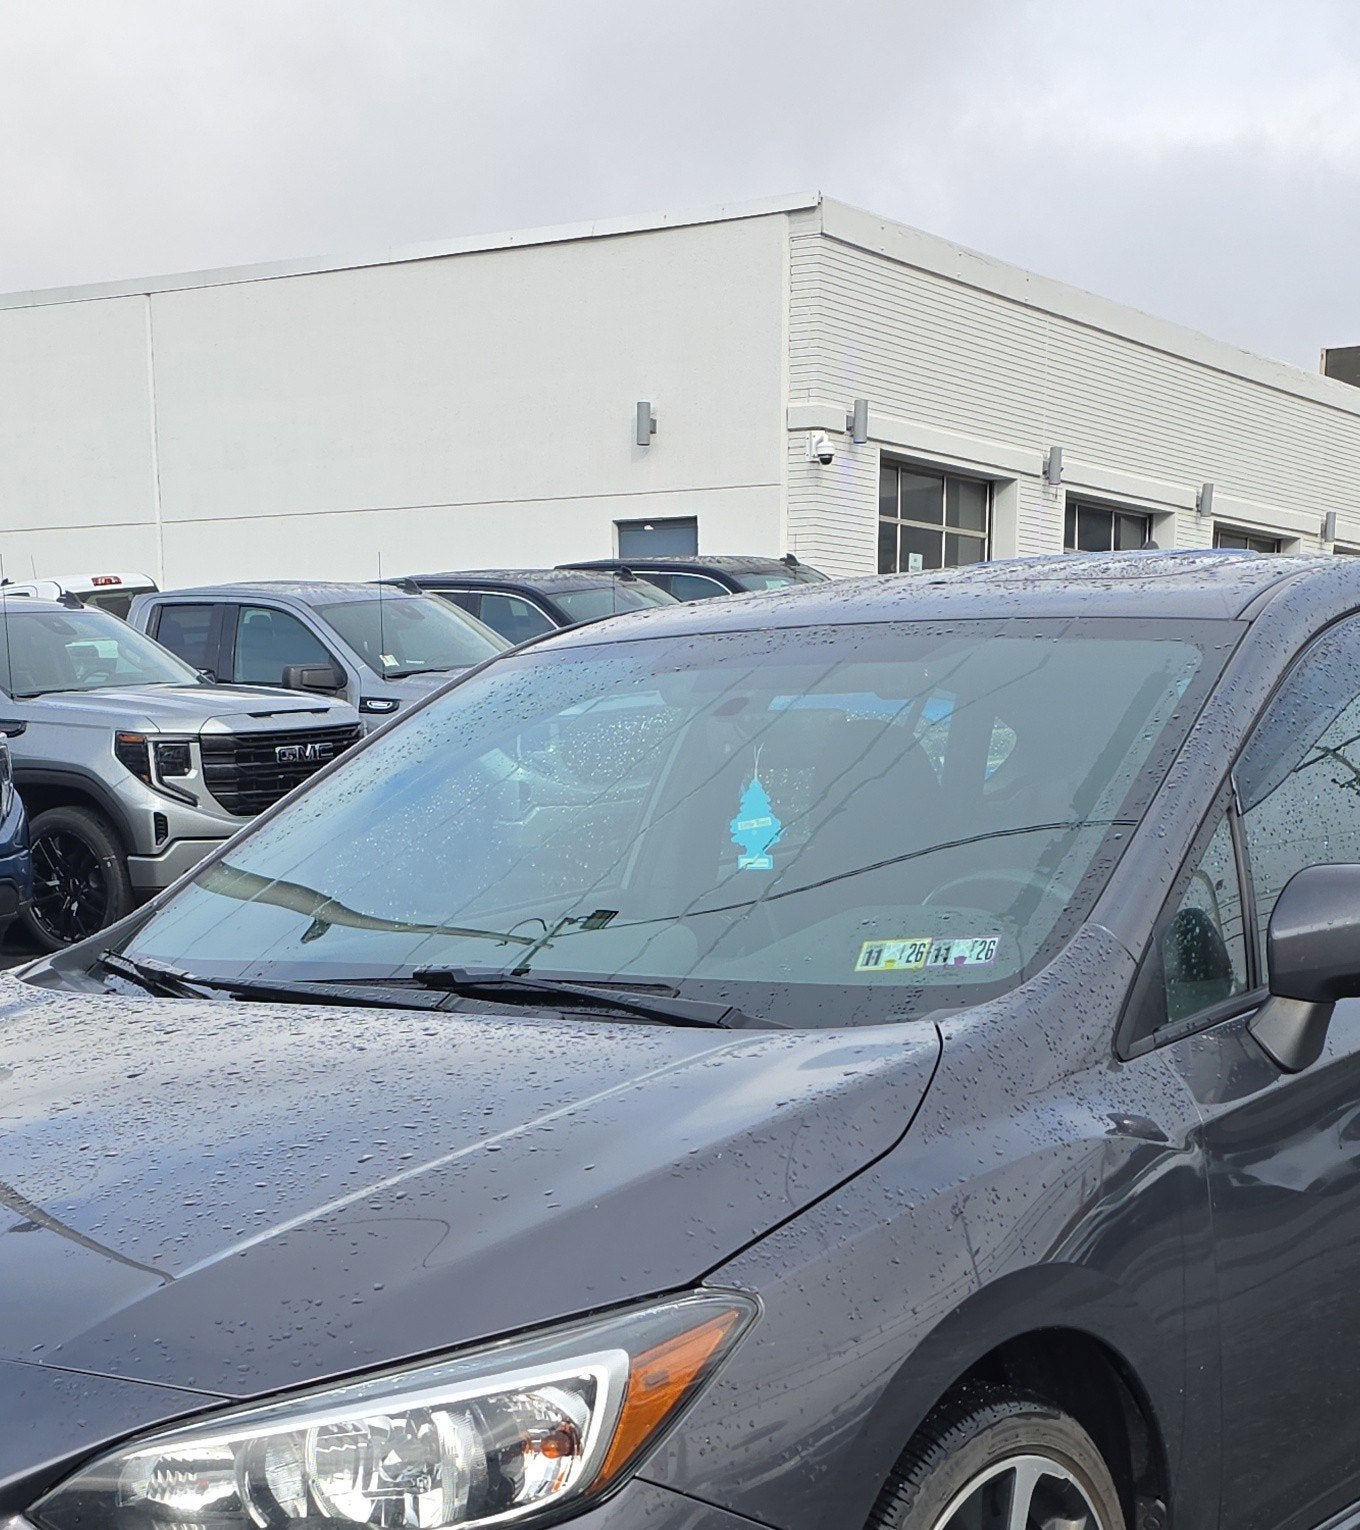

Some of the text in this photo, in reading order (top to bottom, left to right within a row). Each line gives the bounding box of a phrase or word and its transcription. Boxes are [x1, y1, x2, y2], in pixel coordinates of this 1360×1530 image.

[275, 742, 334, 763] GMC
[862, 943, 927, 967] 11 26
[931, 939, 996, 964] 11 26
